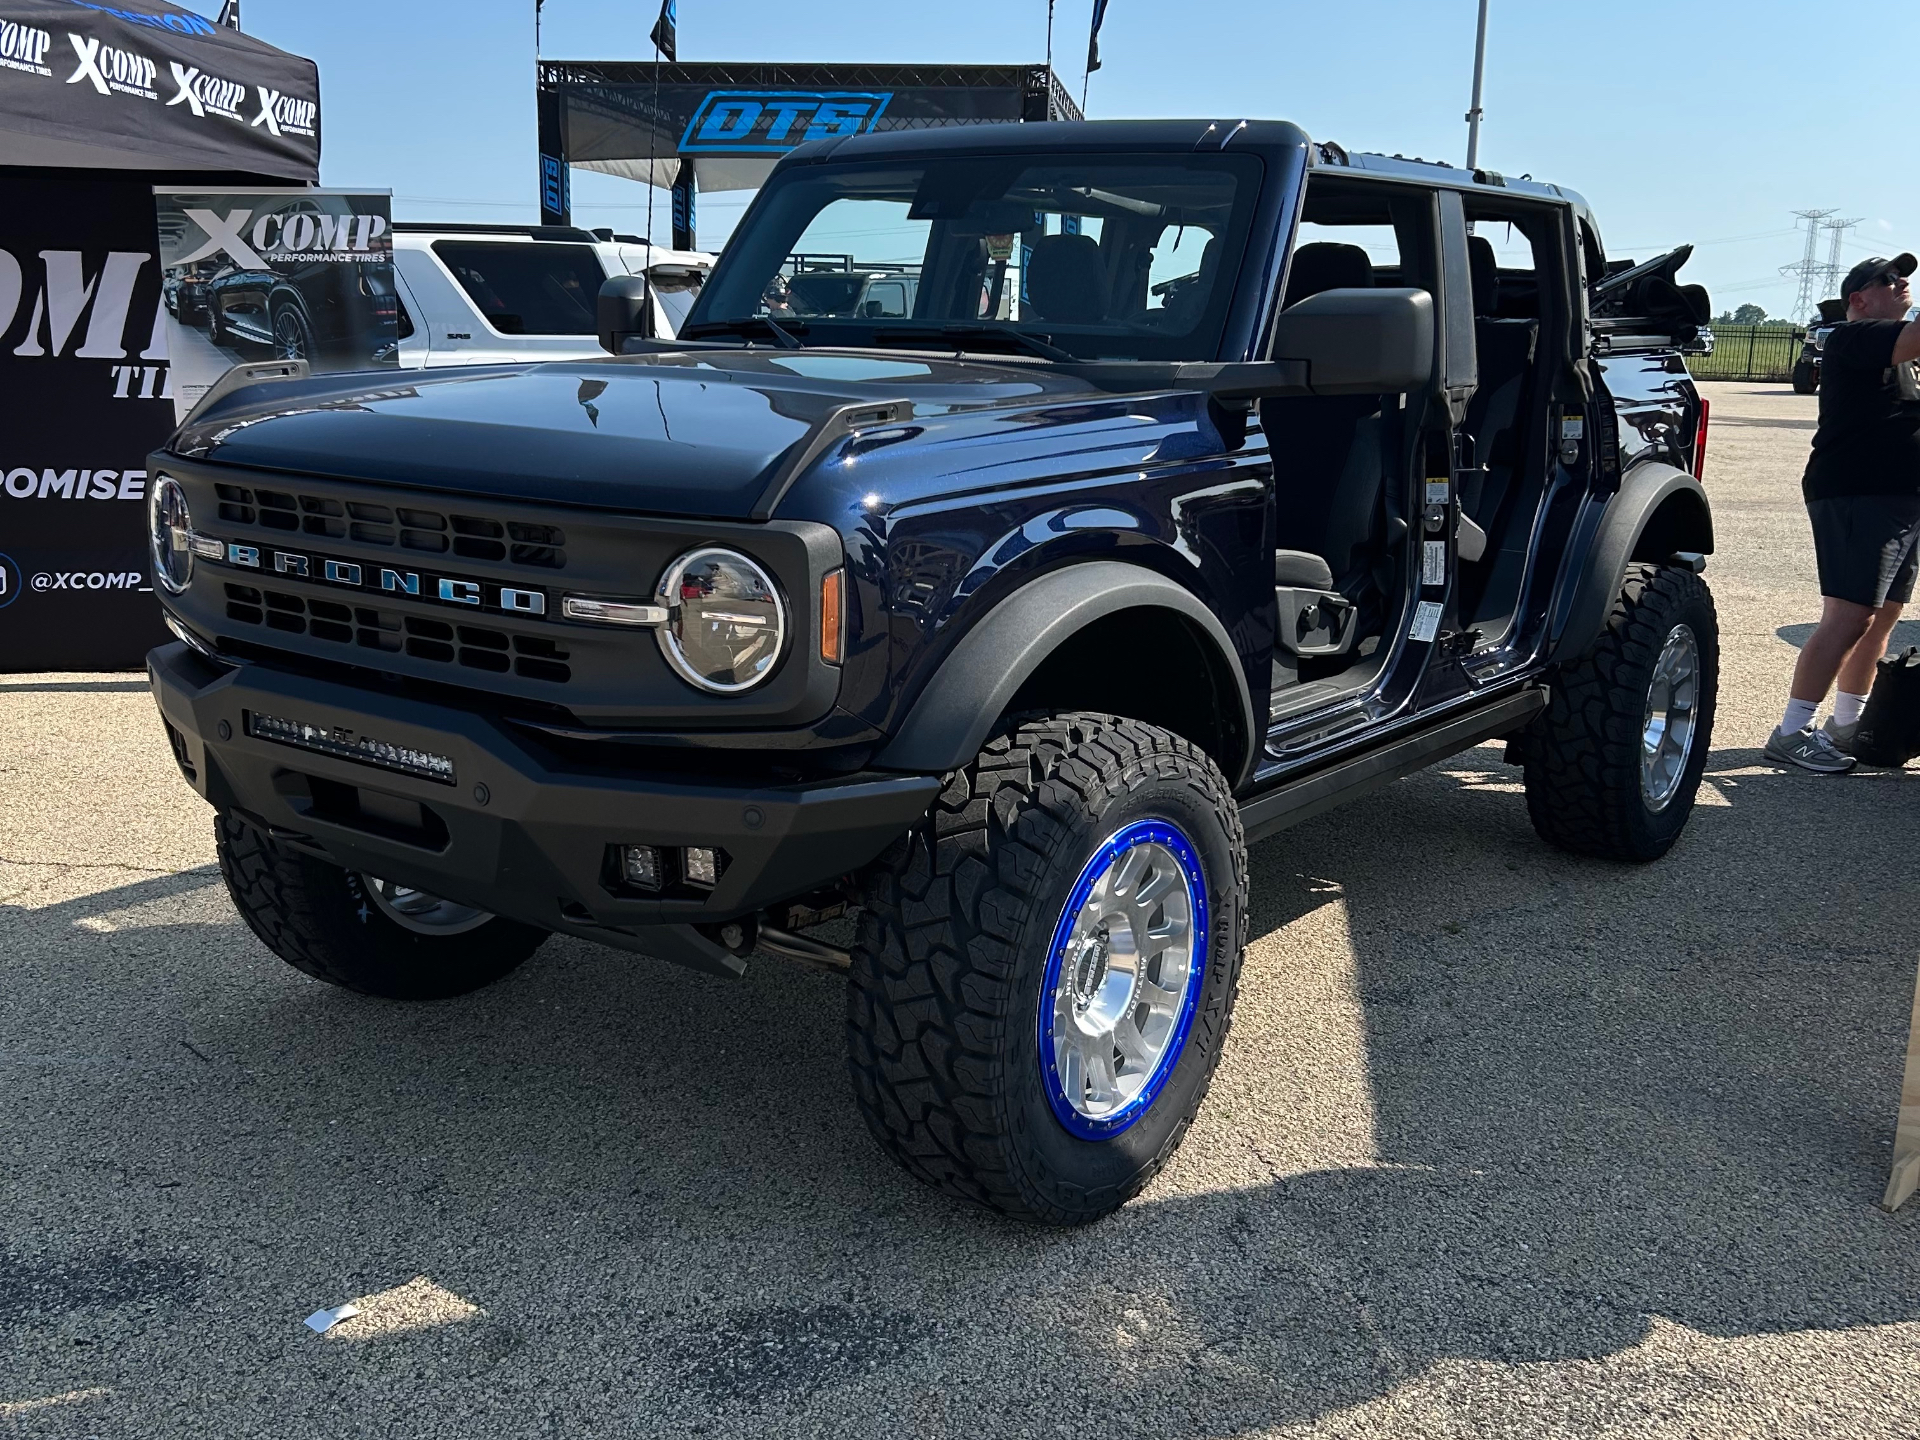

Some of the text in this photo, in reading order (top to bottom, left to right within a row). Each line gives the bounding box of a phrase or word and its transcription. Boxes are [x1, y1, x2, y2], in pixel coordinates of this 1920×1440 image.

[66, 32, 157, 96] XCOMP
[165, 61, 245, 118] XCOMP
[251, 86, 316, 136] XCOMP
[697, 102, 871, 141] DTS
[544, 158, 559, 210] DTS
[674, 188, 683, 227] DTS
[170, 209, 386, 269] XCOMP
[270, 253, 386, 263] PERFORMANCE TIRES
[0, 467, 147, 500] OMISE
[31, 571, 154, 593] @XCOMP_
[228, 543, 545, 615] BRONCO
